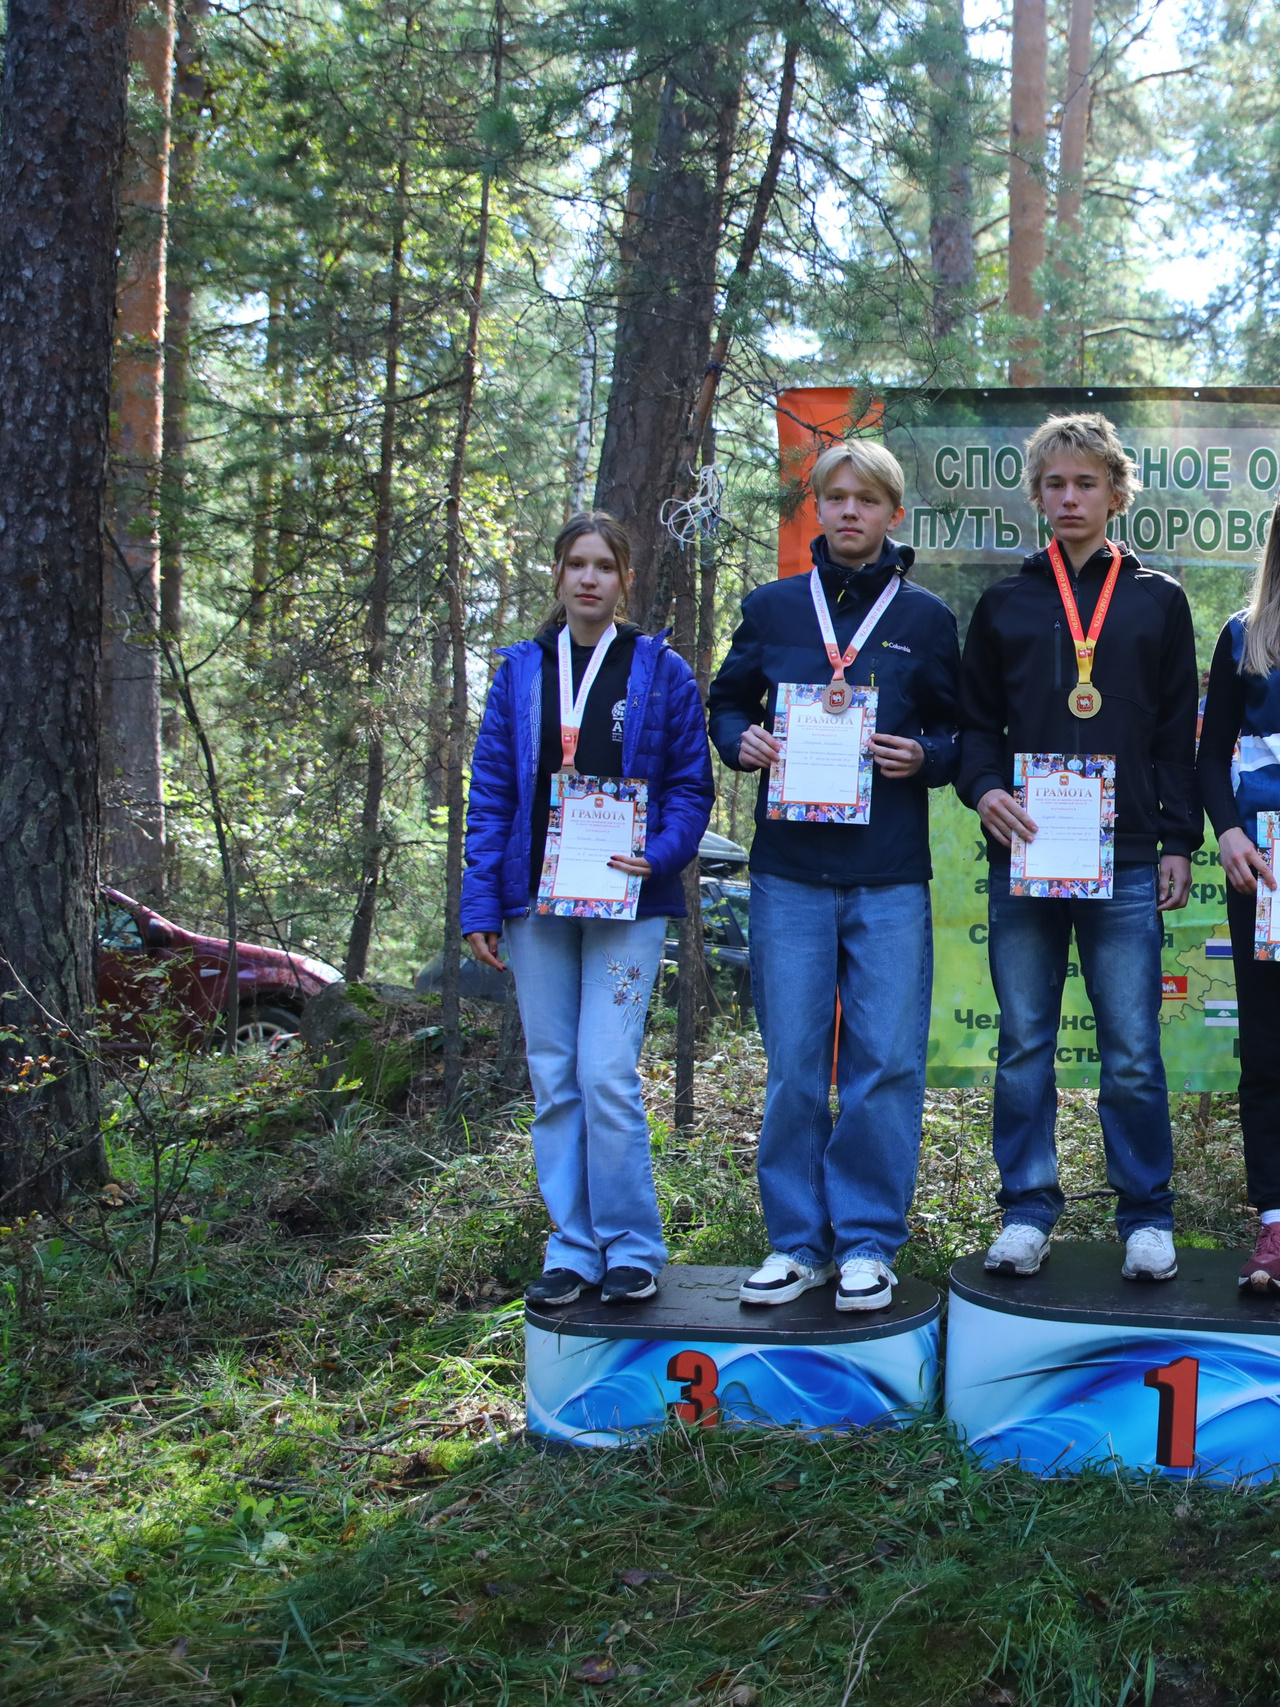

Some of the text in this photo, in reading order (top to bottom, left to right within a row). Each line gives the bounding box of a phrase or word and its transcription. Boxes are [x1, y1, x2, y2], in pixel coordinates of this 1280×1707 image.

[934, 445, 1231, 491] СПОНОЕ
[912, 507, 1021, 550] ПУТЬ
[1053, 553, 1079, 630] ЧЕЛЯБИНСКАЯ ОБЛАСТЬ
[1093, 598, 1107, 628] ОБЛАСТЬ
[797, 714, 854, 726] ГРАМОТА
[1035, 787, 1093, 798] ГРАМОТА
[571, 808, 626, 821] ГРАМОТА
[667, 1349, 719, 1428] 3
[1143, 1355, 1200, 1468] 1
